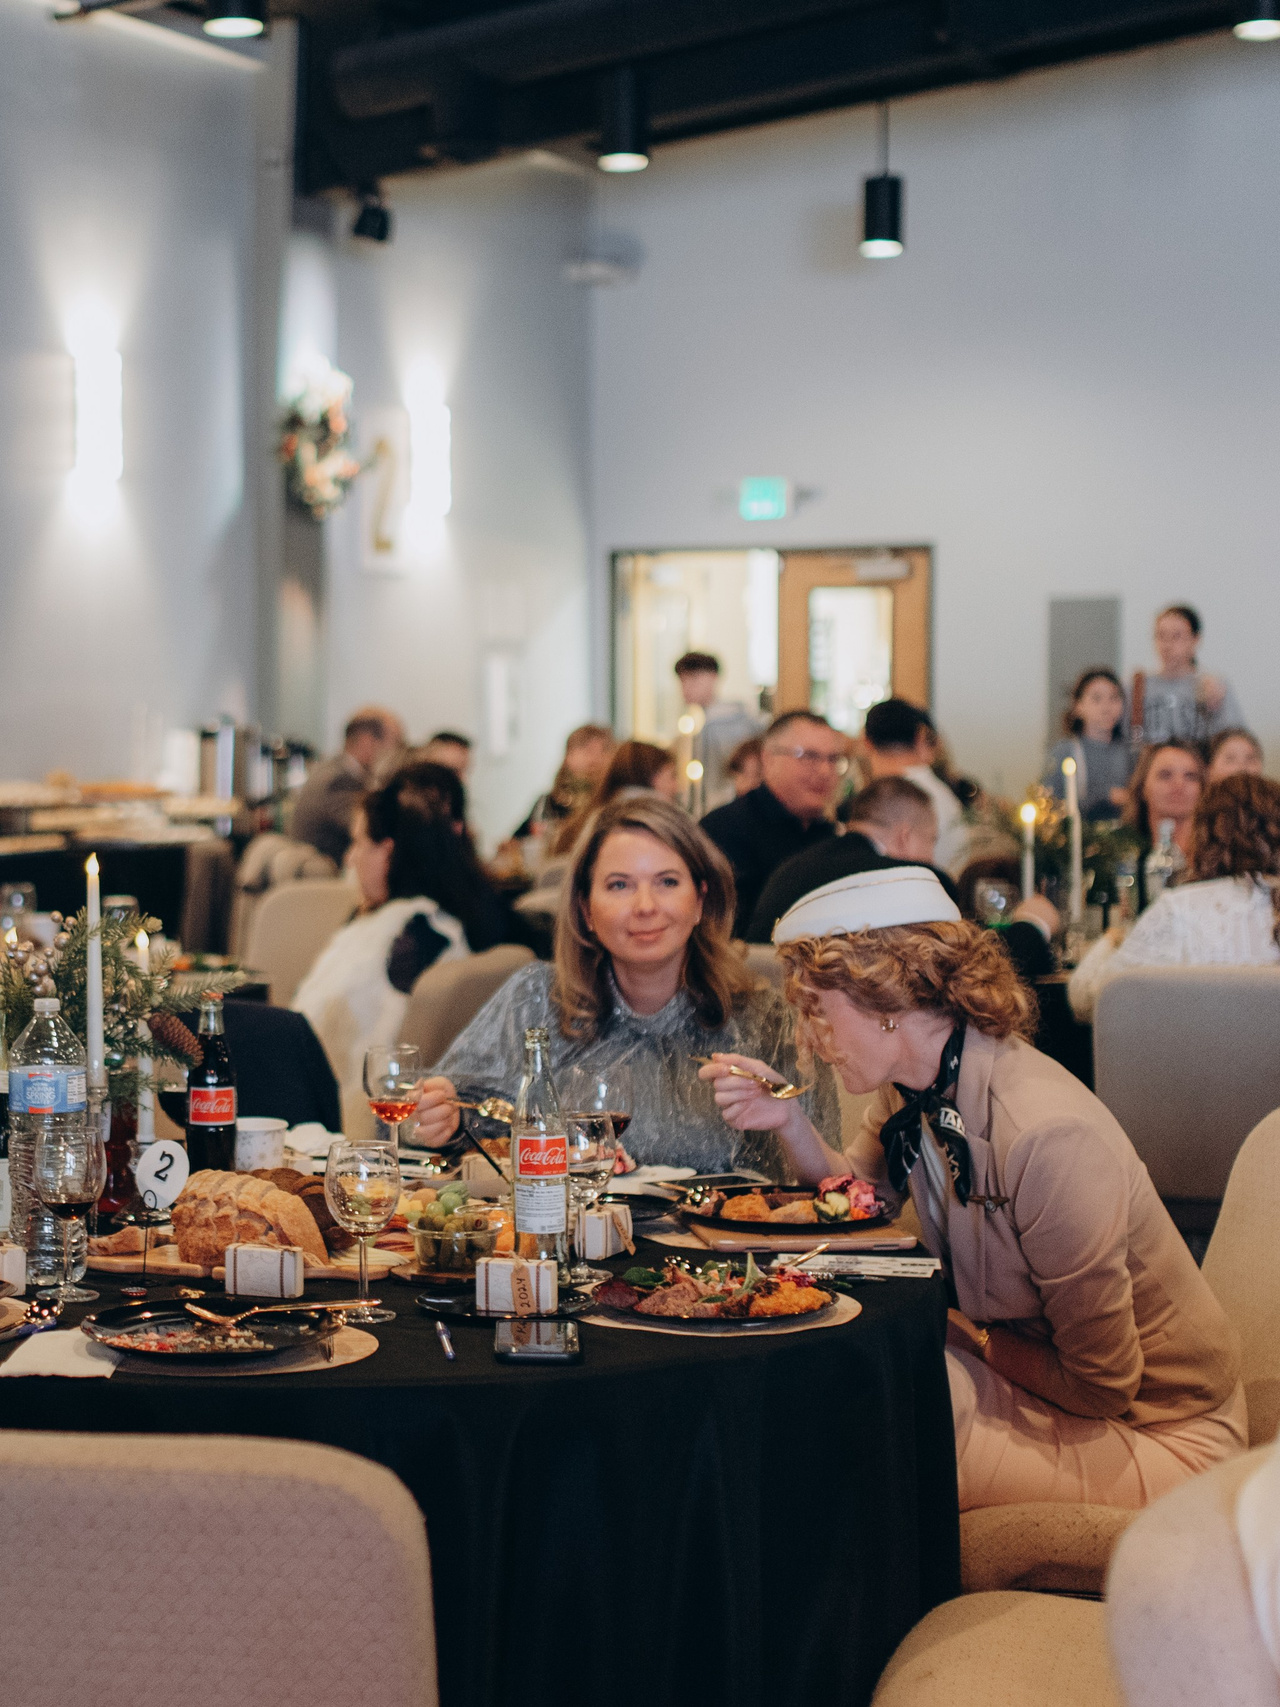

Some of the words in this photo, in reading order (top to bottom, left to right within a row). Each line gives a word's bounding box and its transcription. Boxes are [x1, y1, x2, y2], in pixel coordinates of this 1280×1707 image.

[26, 1092, 56, 1100] SPRING
[192, 1098, 233, 1114] Coca-Cola
[153, 1150, 174, 1182] 2
[520, 1147, 567, 1166] Coca-Cola
[516, 1277, 531, 1308] 2024
